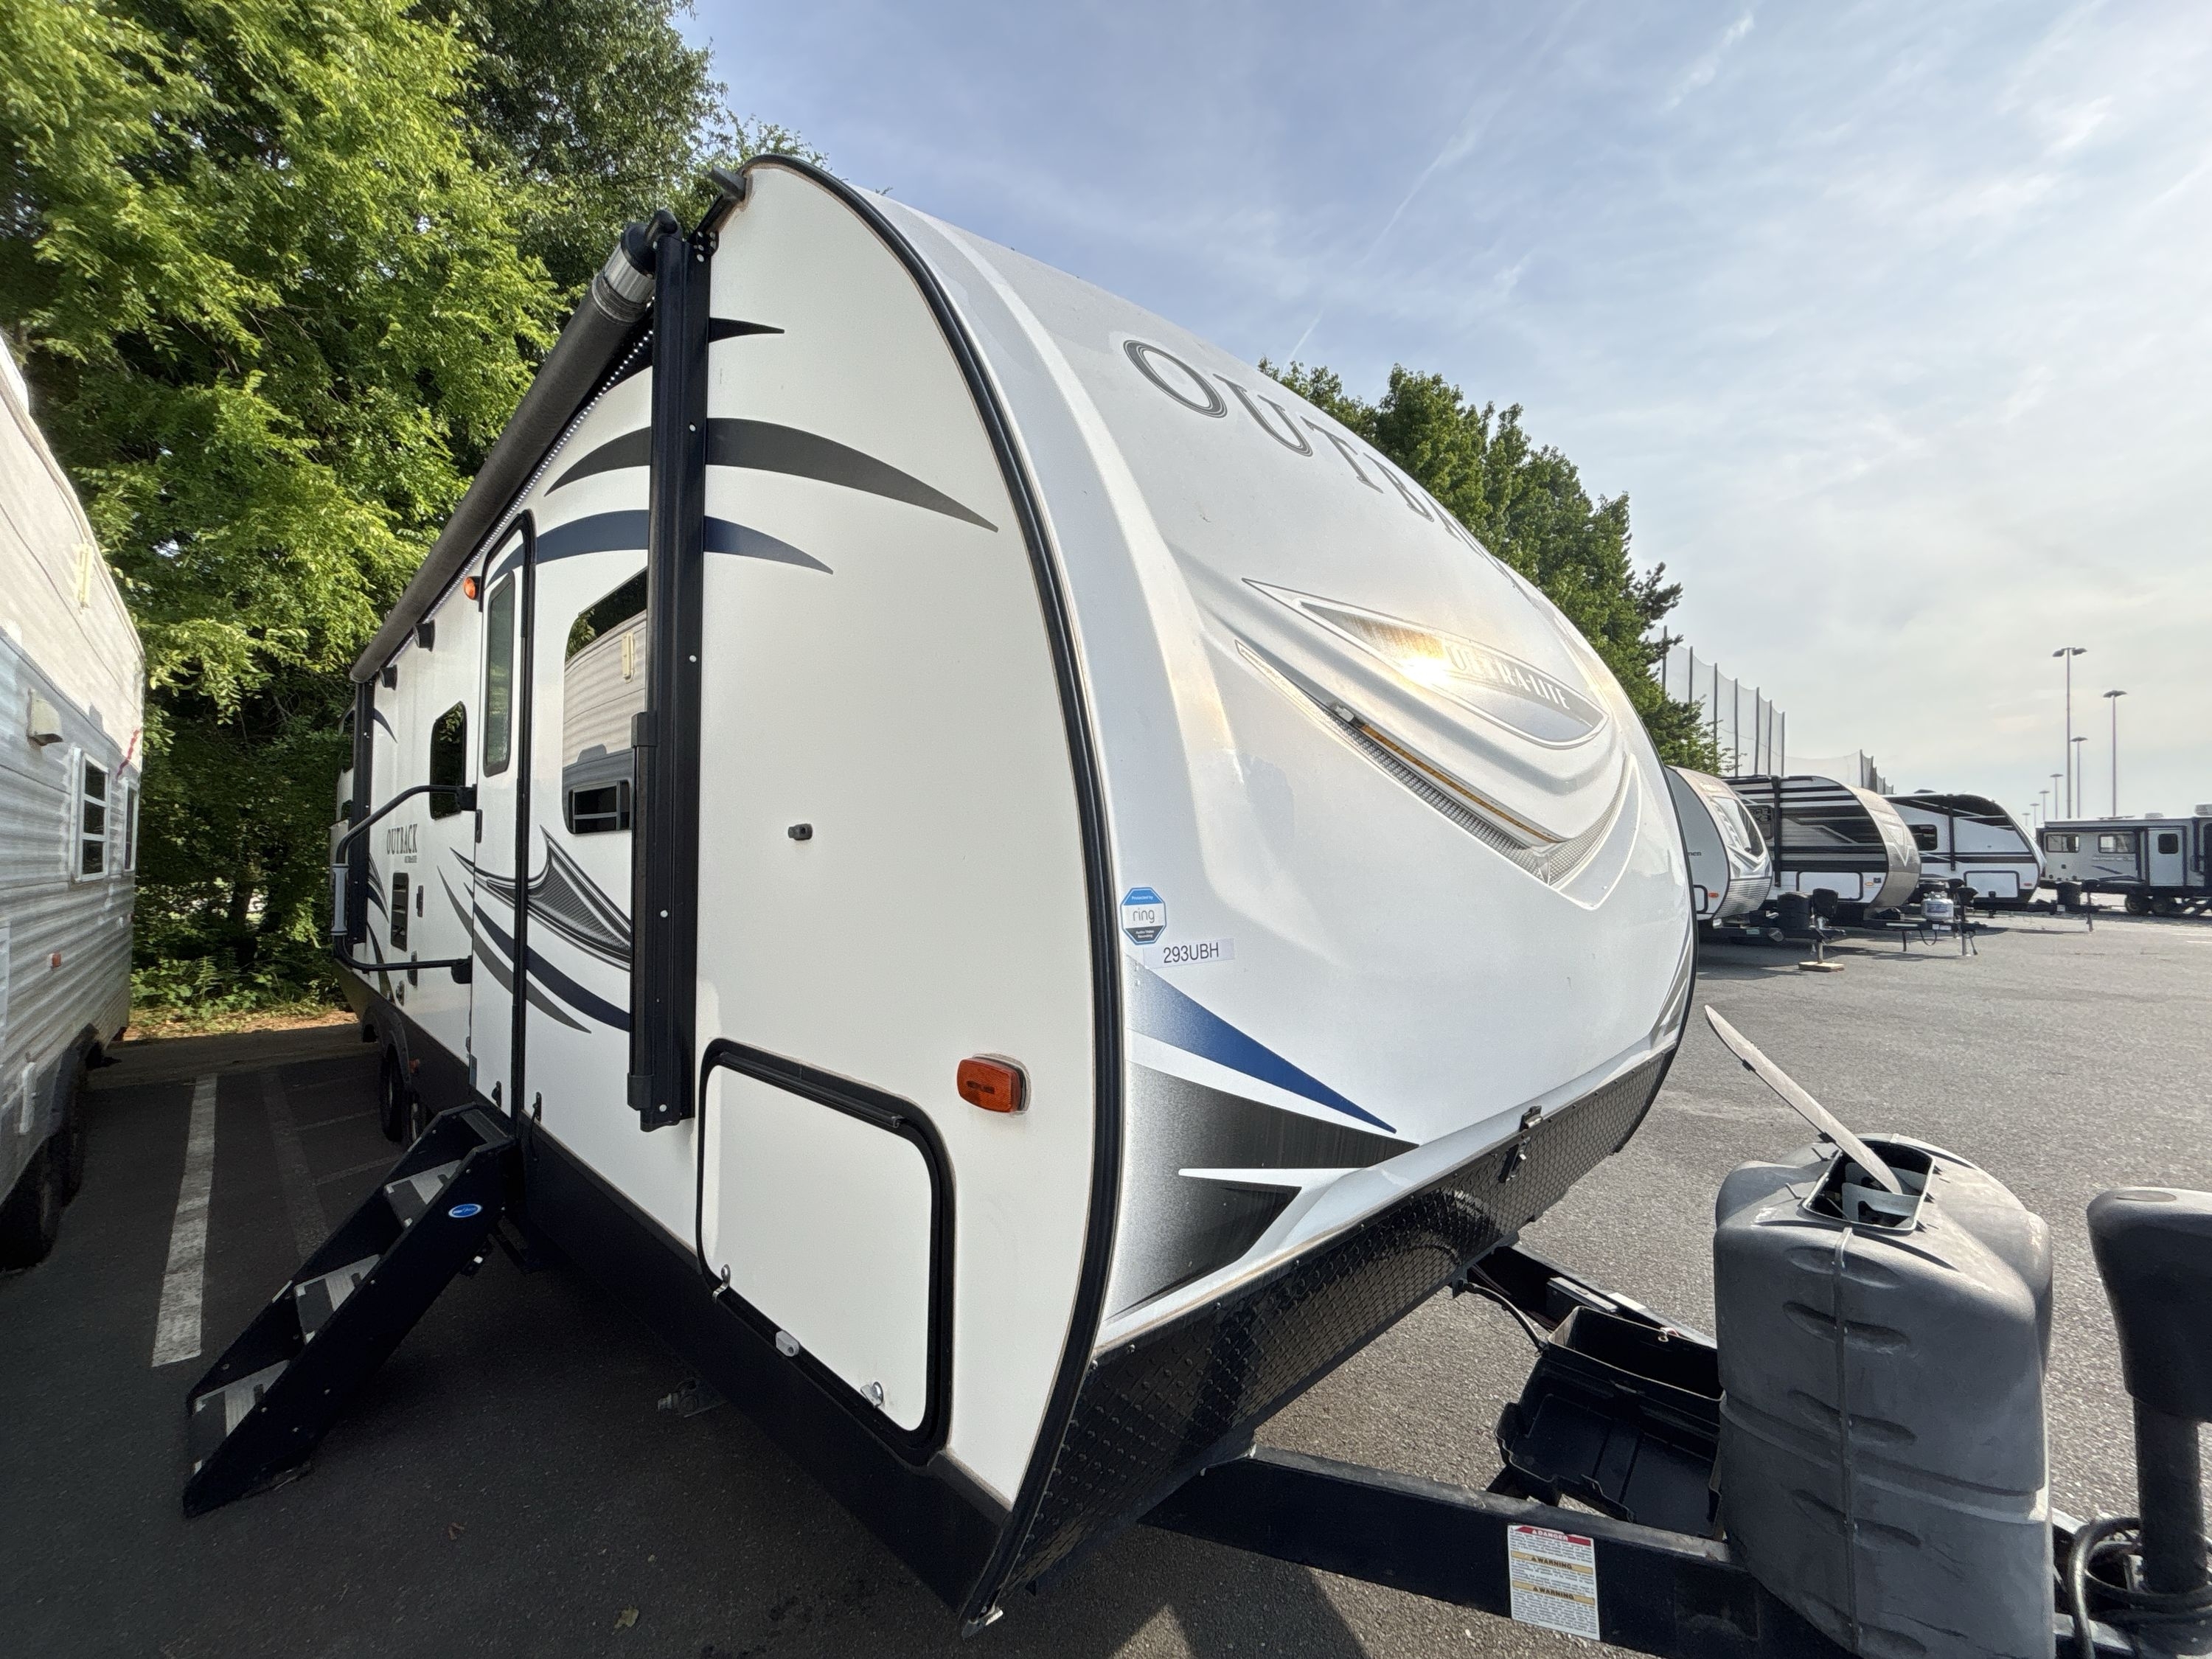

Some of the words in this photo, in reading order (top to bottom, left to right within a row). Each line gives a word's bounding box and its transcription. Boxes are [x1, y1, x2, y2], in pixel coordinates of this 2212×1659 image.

[386, 824, 418, 855] OUTBACK
[1133, 908, 1155, 924] ring
[1163, 942, 1220, 964] 293UBH
[1537, 1530, 1569, 1541] DANGER
[1537, 1557, 1573, 1569] WARNING
[1539, 1587, 1575, 1599] WARNING
